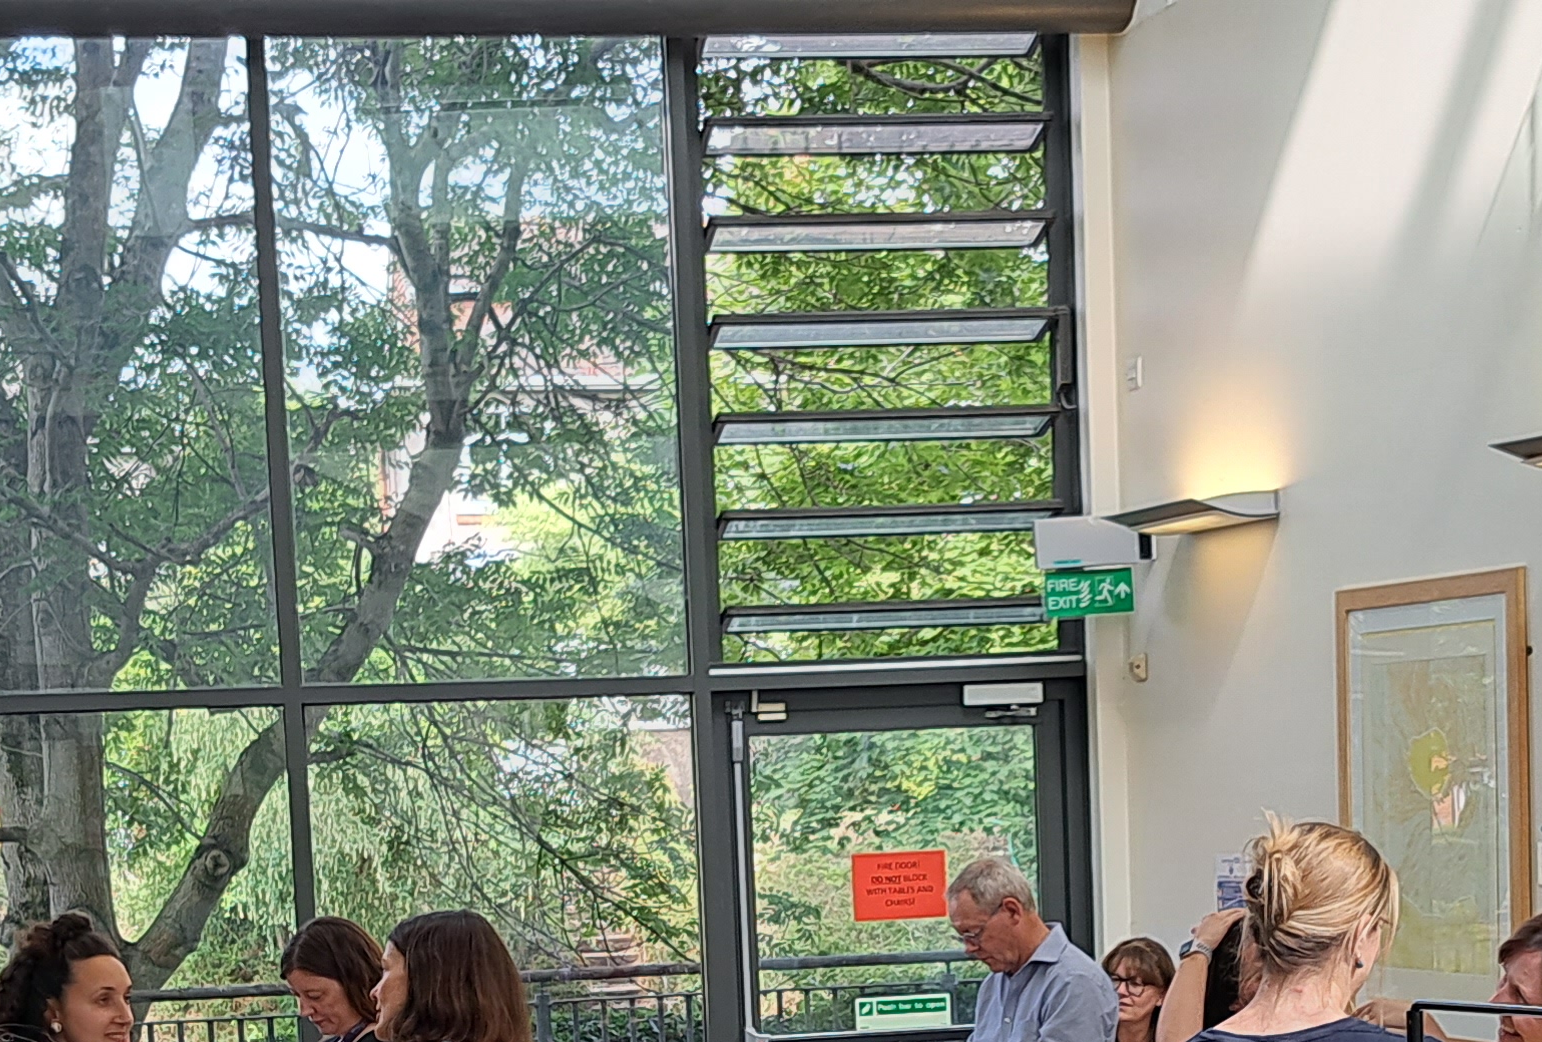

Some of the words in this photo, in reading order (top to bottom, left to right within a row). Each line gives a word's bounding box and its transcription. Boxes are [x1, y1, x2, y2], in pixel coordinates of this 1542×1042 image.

[1047, 578, 1079, 592] FIRE
[1048, 595, 1080, 610] EXIT
[871, 876, 883, 884] DO
[885, 875, 901, 884] NOT
[866, 888, 887, 896] WITH
[888, 886, 915, 895] TABLES
[917, 885, 934, 893] AND
